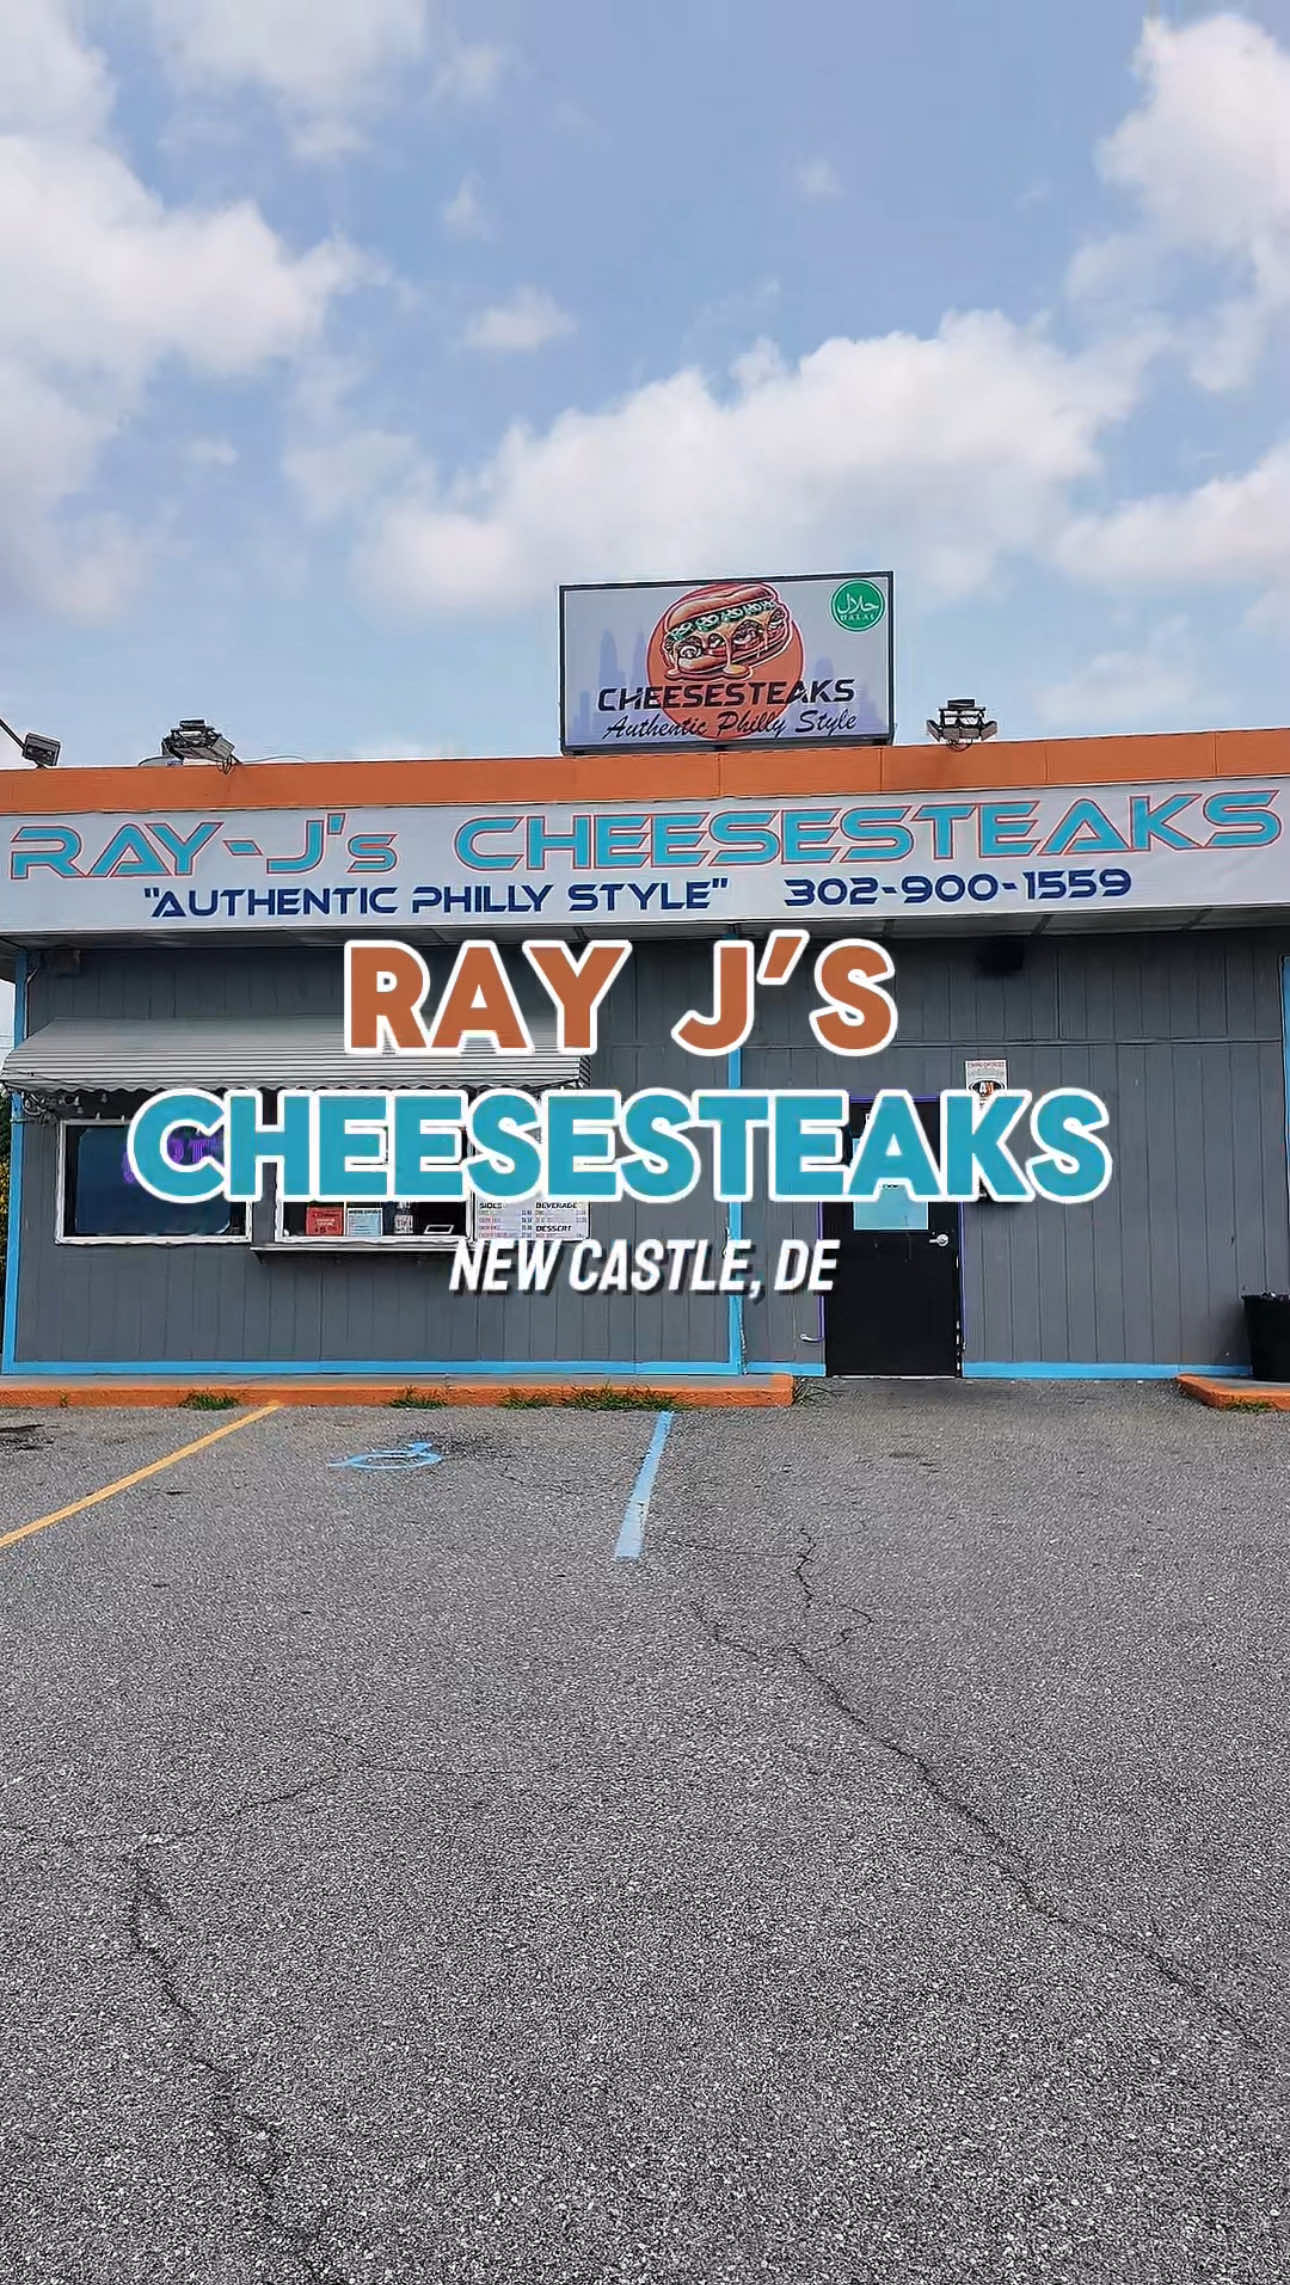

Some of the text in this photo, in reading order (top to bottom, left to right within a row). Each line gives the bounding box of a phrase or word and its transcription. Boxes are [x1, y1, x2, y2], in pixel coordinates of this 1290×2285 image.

[598, 678, 856, 712] CHEESESTEAKS
[602, 709, 857, 740] Authentic Philly Style
[453, 789, 1281, 873] CHEESESTEAKS
[143, 868, 1133, 919] "AUTHENTIC PHILLY STYLE" 302-900-1559
